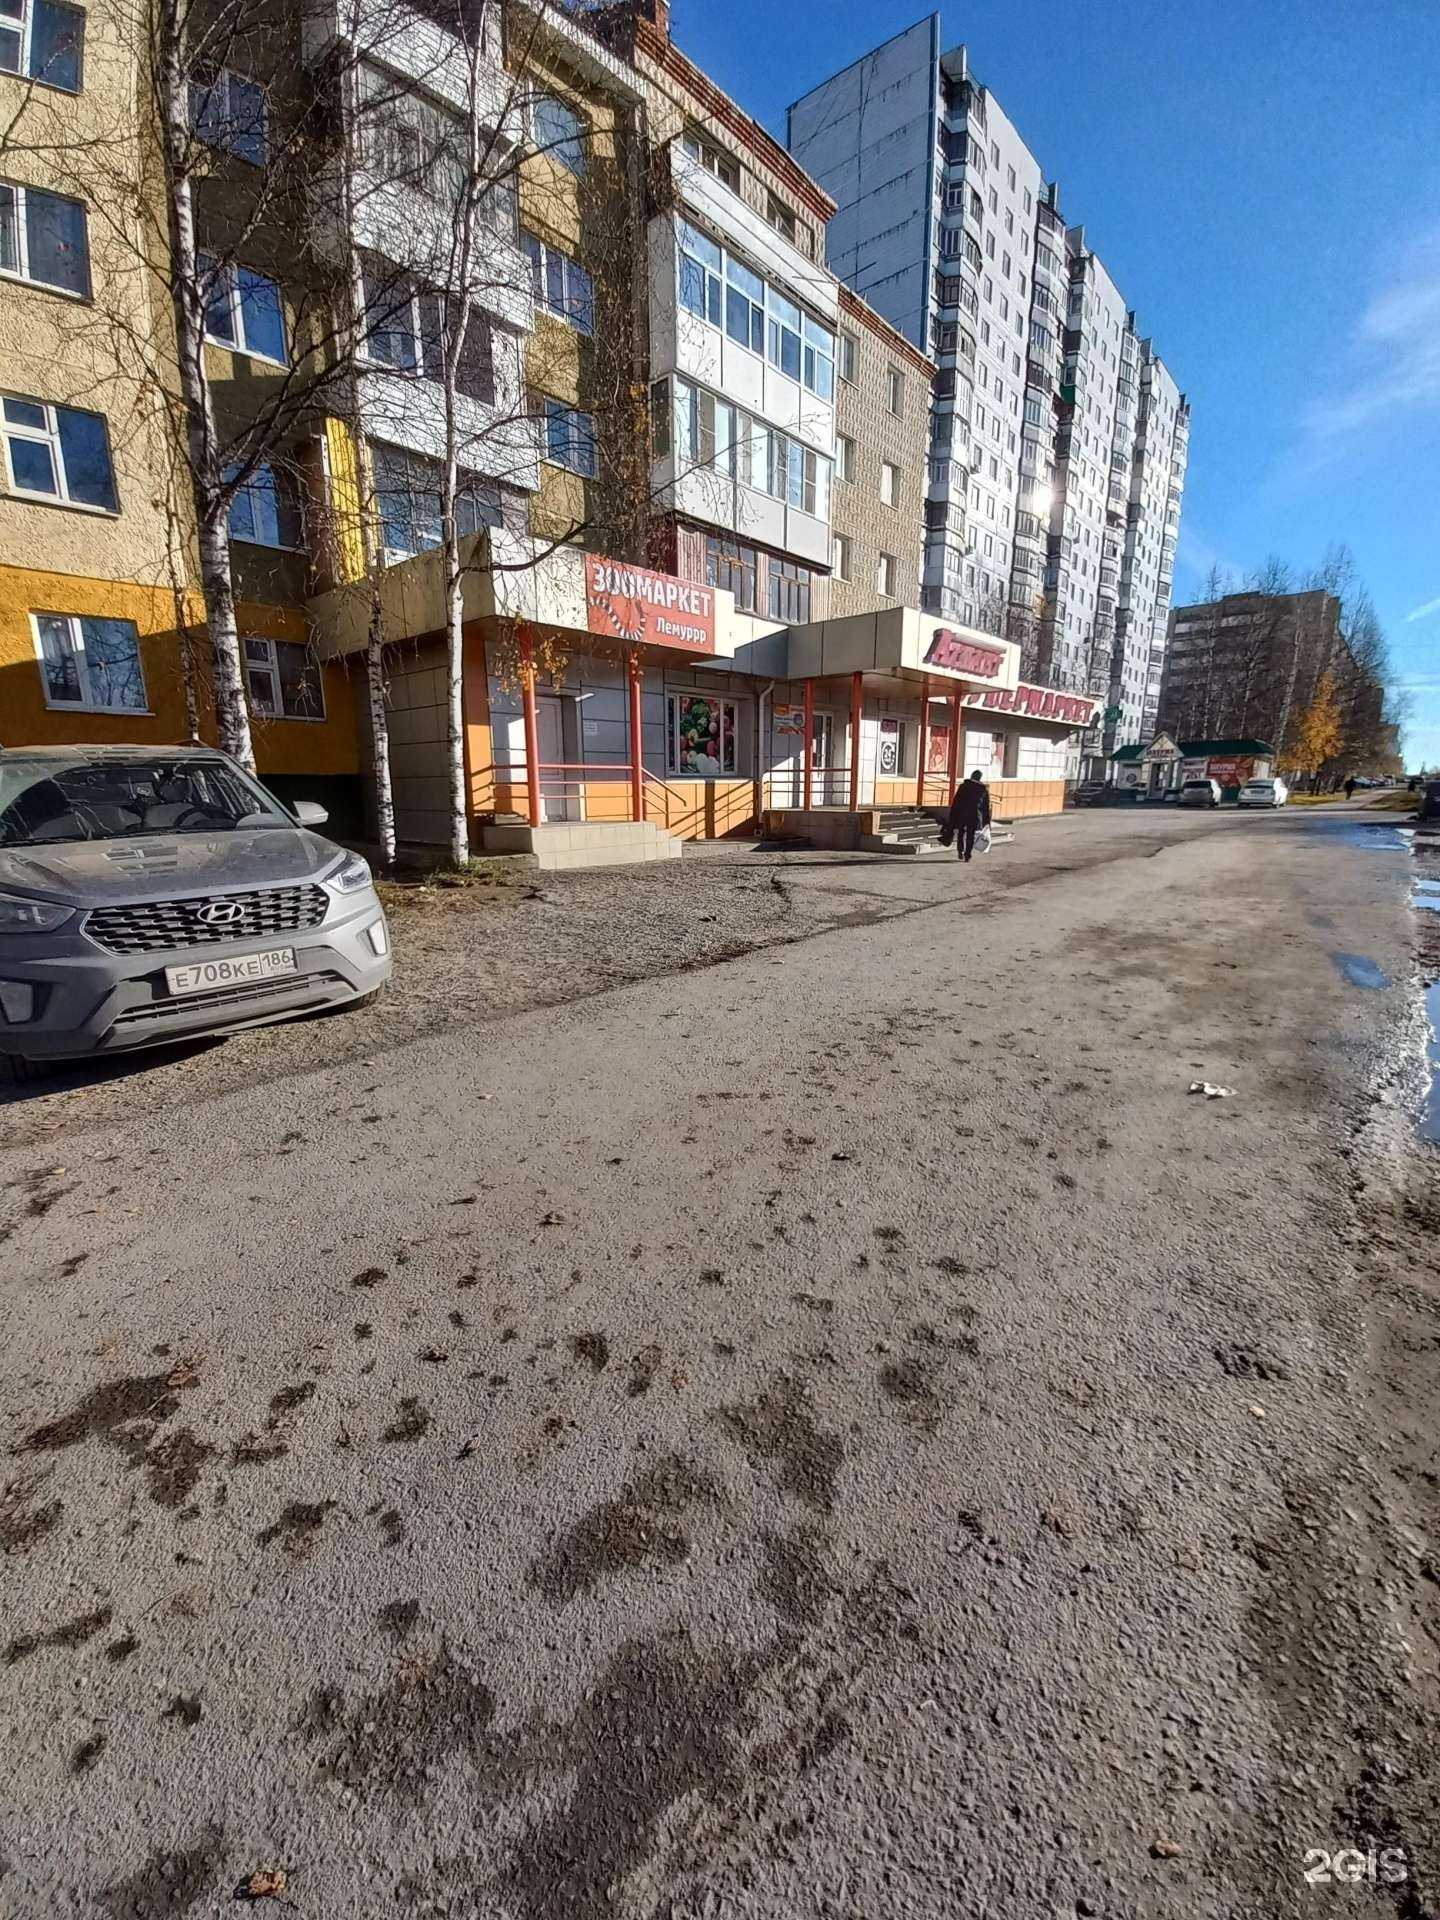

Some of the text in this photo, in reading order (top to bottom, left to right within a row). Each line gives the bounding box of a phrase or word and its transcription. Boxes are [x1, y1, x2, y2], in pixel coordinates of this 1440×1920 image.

[592, 562, 711, 617] ЗООМАРКЕТ
[656, 617, 707, 644] Лемуррр
[175, 951, 291, 988] Е708КЕ 186
